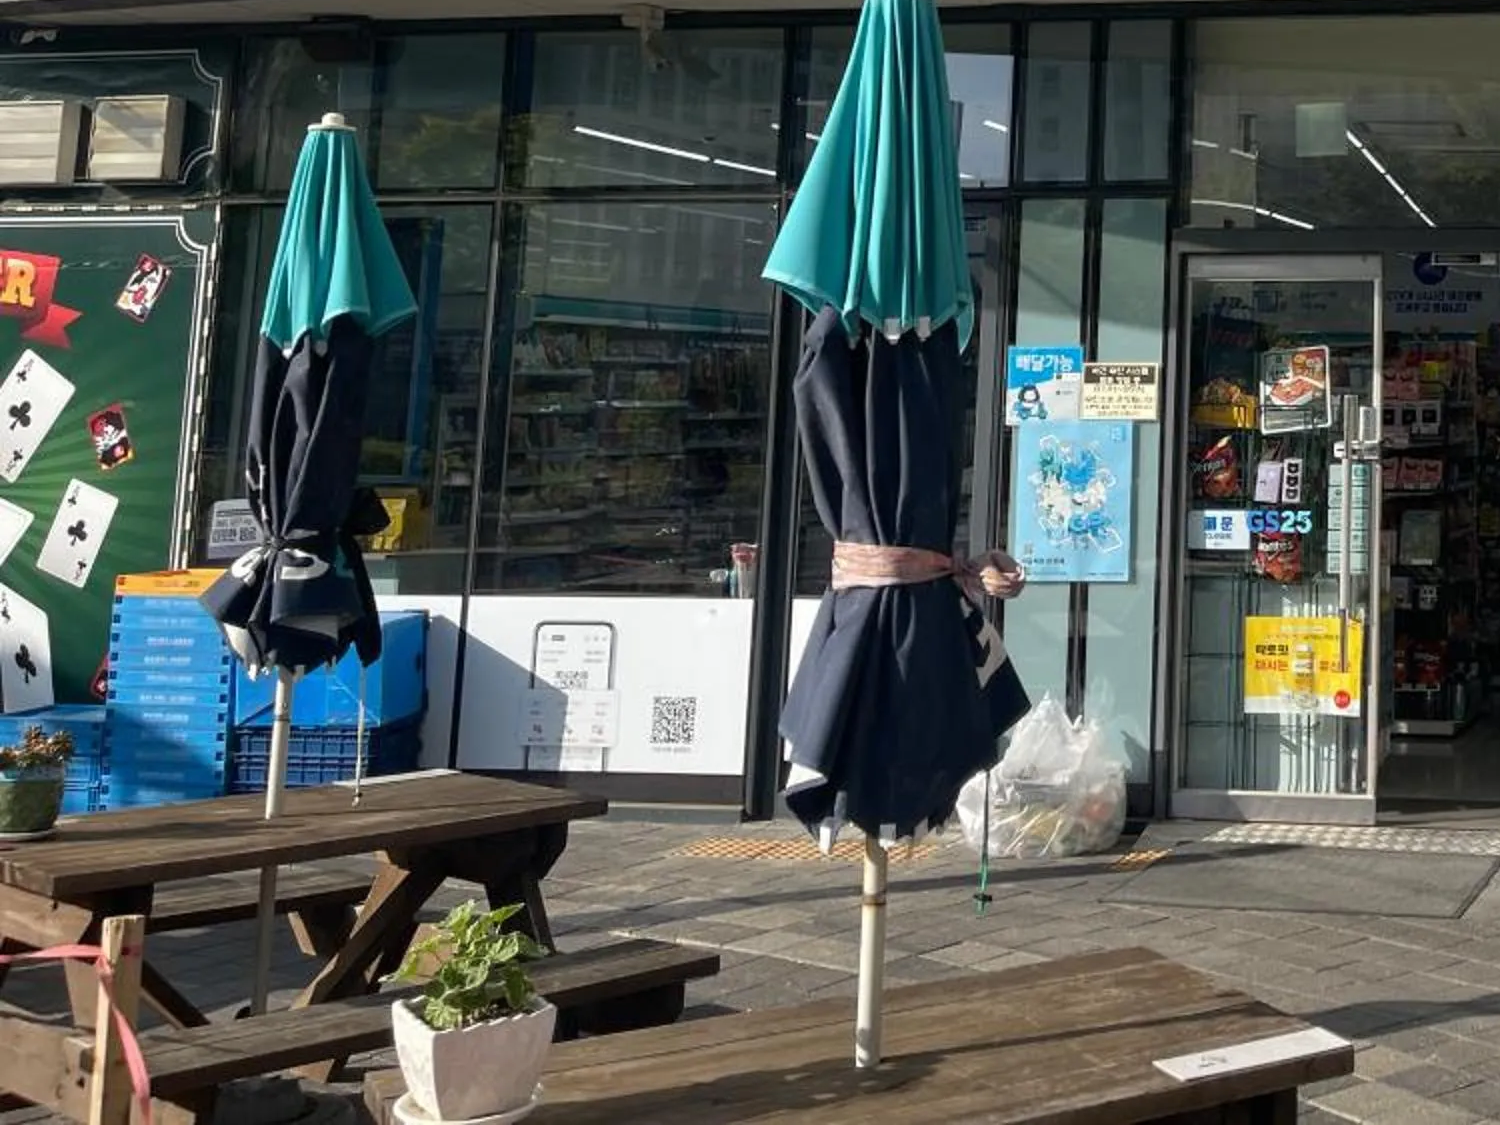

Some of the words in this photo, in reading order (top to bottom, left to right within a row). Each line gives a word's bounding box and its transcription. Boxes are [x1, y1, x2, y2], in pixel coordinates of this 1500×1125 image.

[0, 258, 36, 307] R
[1015, 354, 1074, 372] 배달가능
[1246, 510, 1313, 534] GS25
